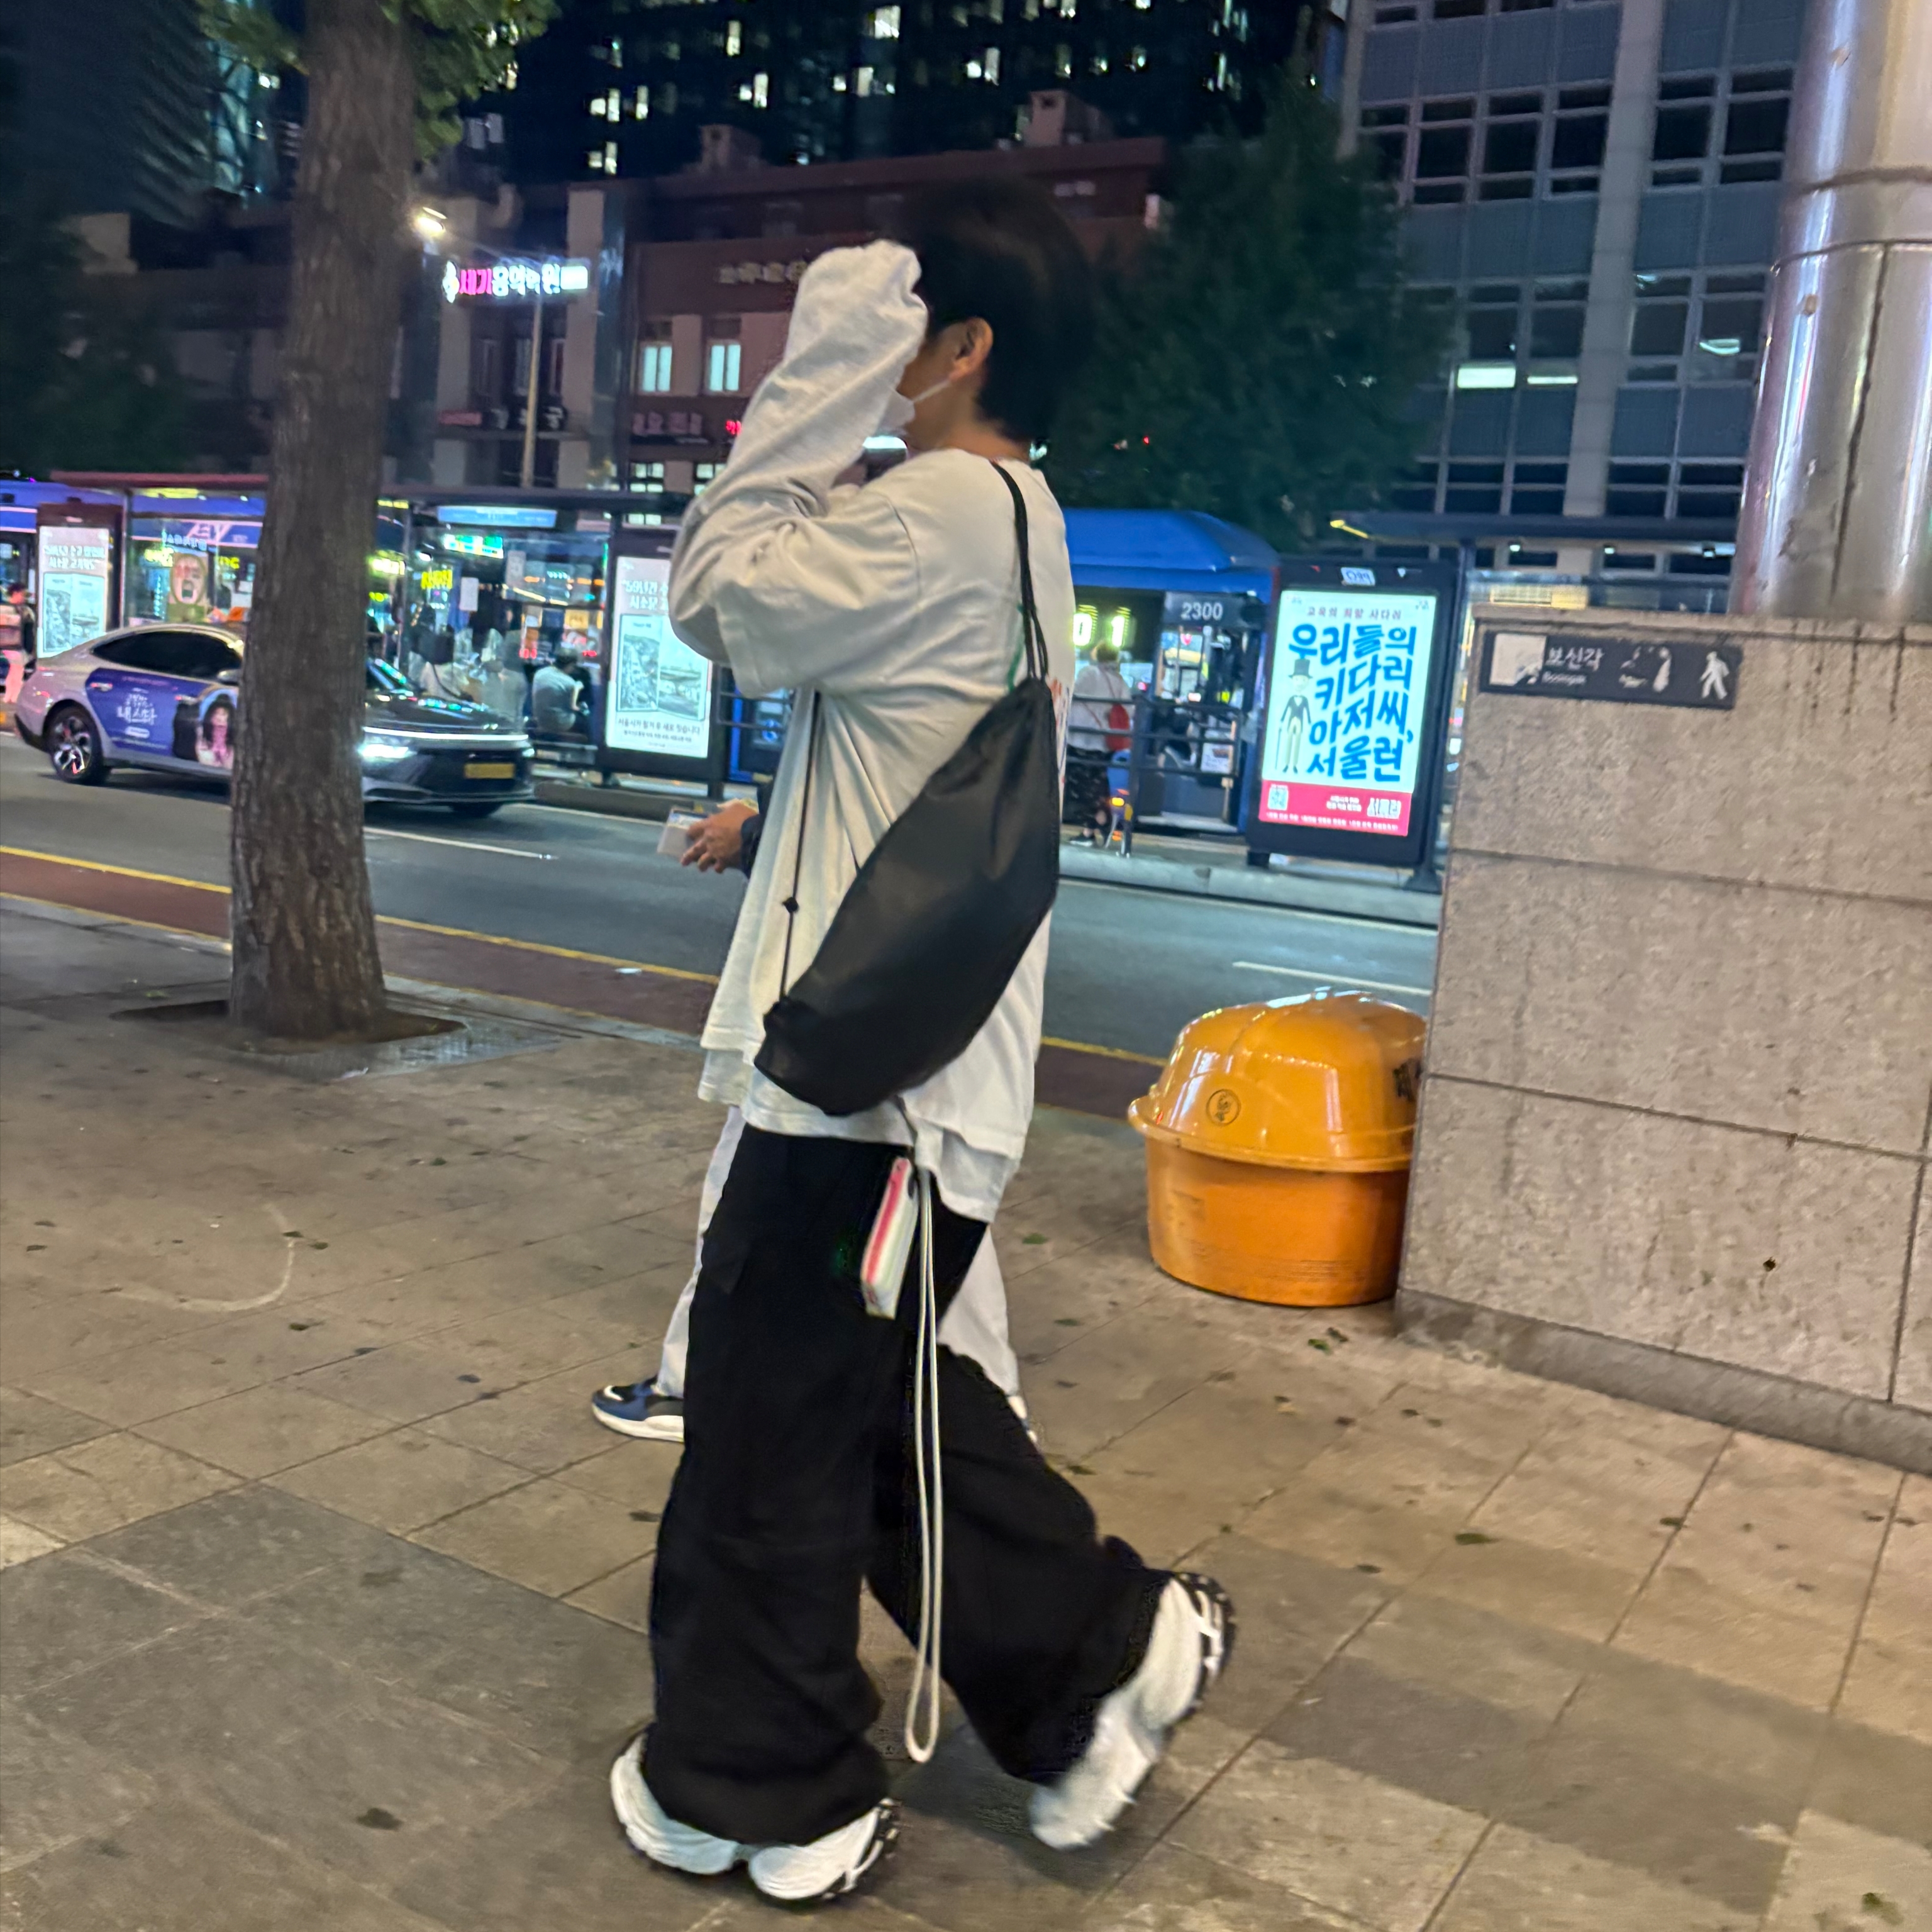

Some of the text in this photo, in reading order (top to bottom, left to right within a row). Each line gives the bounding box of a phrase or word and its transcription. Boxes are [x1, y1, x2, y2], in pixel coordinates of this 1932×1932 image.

[1180, 601, 1223, 621] 2300
[1307, 606, 1338, 618] 교육의
[1369, 609, 1402, 621] 사다리
[1289, 623, 1416, 665] 우리들의
[1545, 647, 1604, 671] 보신각
[1315, 654, 1413, 710] 키다리
[1309, 689, 1414, 745] 아저씨,
[1306, 735, 1404, 782] 서울런
